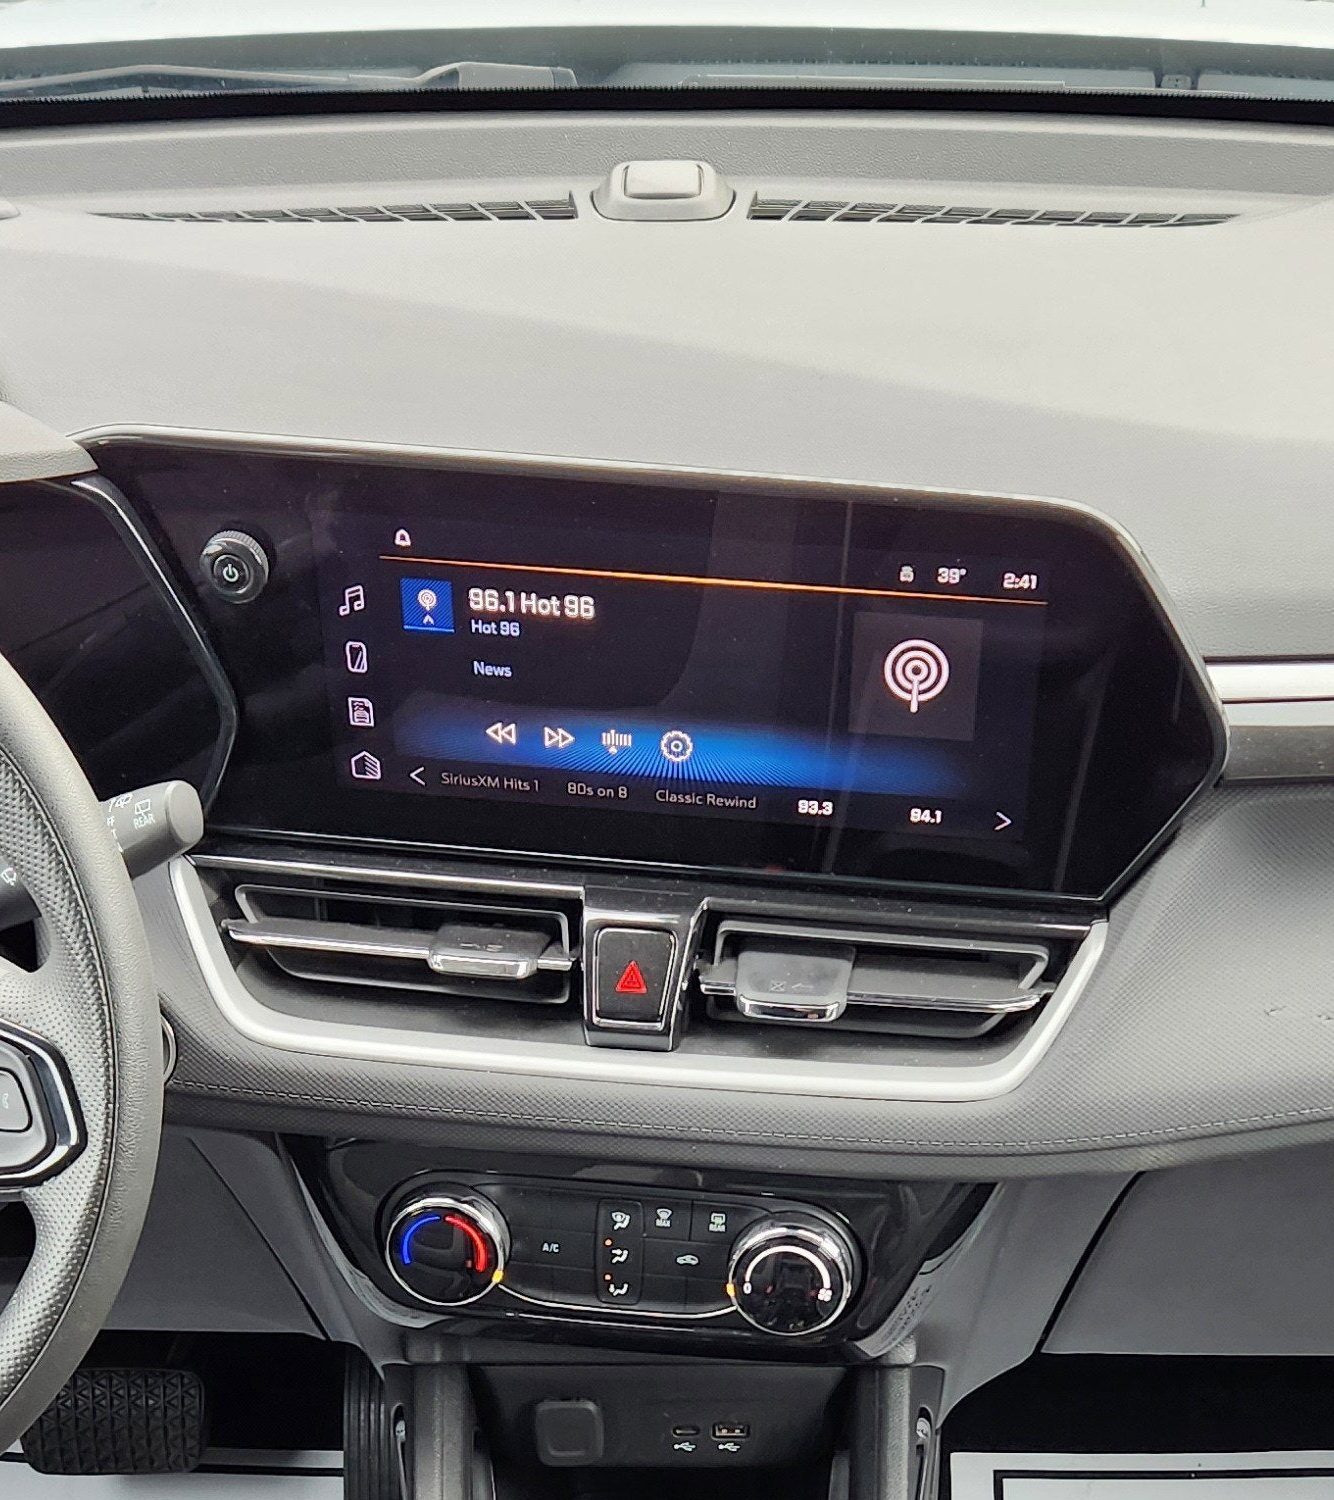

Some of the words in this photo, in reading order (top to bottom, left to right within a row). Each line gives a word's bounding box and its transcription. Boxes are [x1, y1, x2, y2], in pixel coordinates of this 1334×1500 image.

[1003, 573, 1038, 590] 2:41
[469, 588, 515, 613] 96.1
[520, 592, 561, 616] Hot
[563, 594, 595, 619] 96
[471, 619, 498, 635] Hot
[500, 621, 520, 637] 96
[473, 660, 512, 678] News
[441, 772, 500, 789] SiriusXM
[504, 777, 530, 792] Hits
[597, 787, 614, 798] on
[618, 786, 628, 799] 8
[655, 789, 703, 806] Classic
[706, 793, 757, 809] Rewind
[133, 814, 156, 830] REAR
[542, 1241, 559, 1253] A/C
